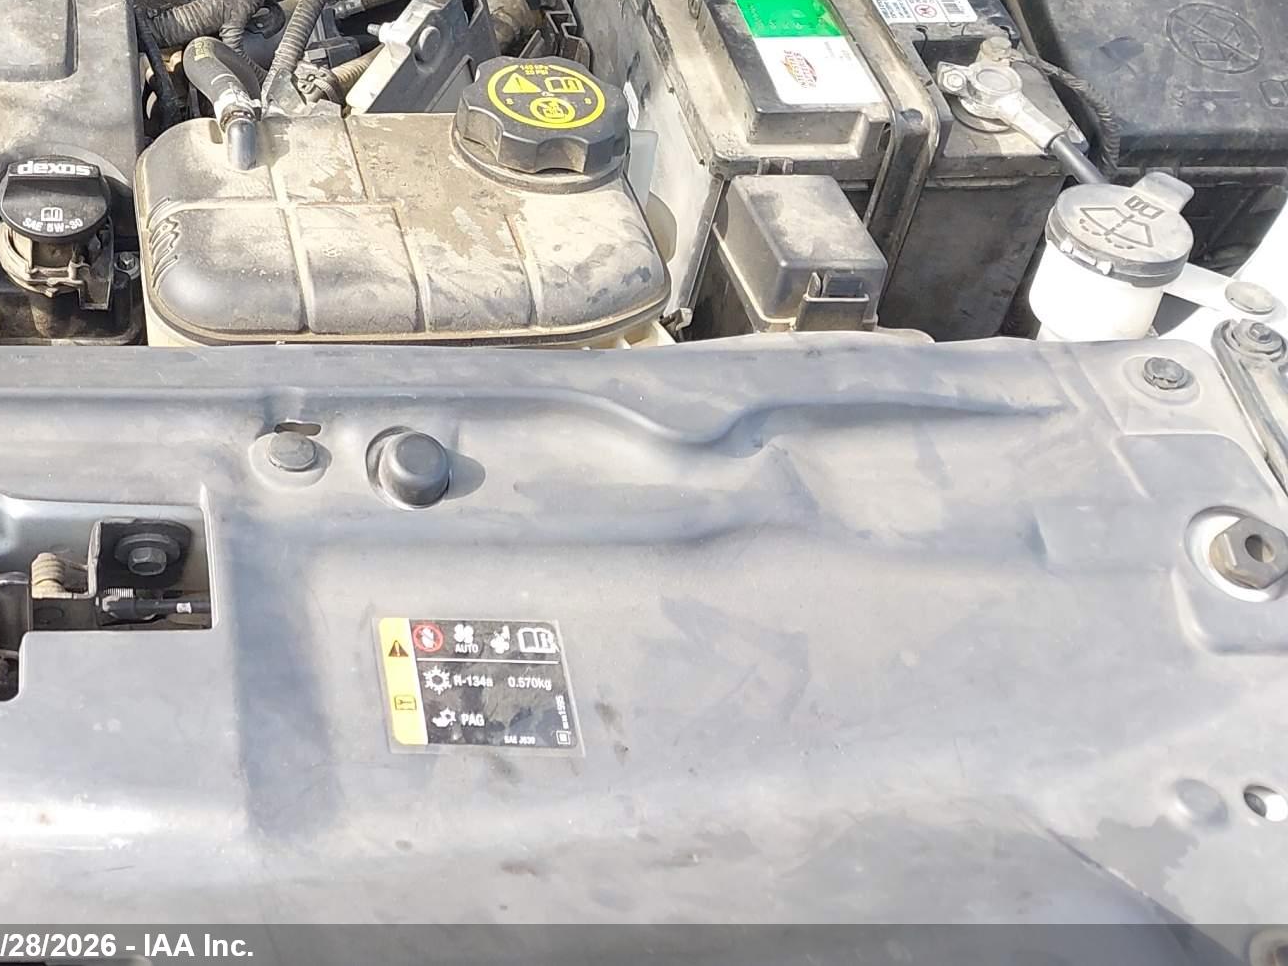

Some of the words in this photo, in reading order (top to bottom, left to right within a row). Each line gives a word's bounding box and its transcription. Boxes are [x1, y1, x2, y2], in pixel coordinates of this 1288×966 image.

[17, 160, 92, 176] dexos
[23, 217, 43, 232] SAE
[46, 218, 83, 233] 5W-30
[455, 644, 478, 653] AUTO
[453, 675, 493, 687] R-134a
[508, 677, 552, 691] 0.570kg
[461, 714, 485, 726] PAG
